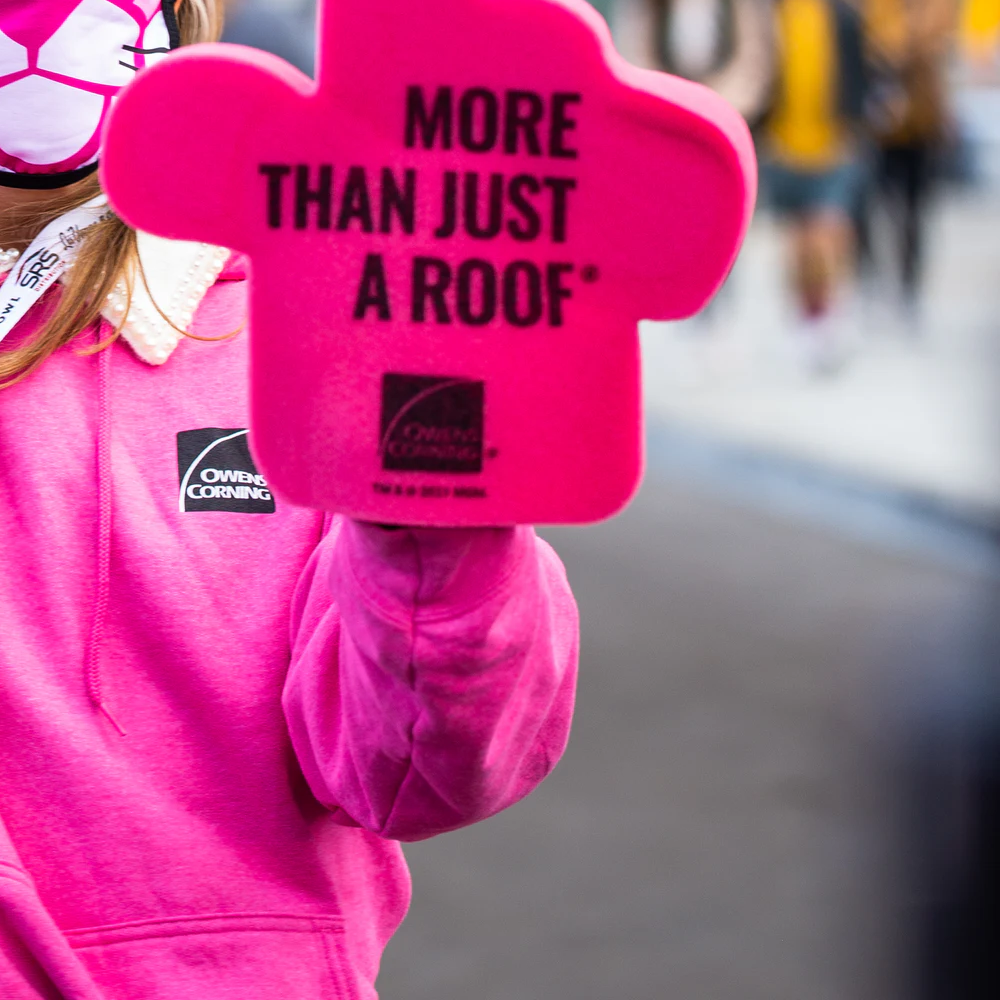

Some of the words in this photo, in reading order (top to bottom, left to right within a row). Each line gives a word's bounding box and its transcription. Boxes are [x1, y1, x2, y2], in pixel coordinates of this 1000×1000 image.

[404, 84, 582, 160] MORE
[258, 163, 416, 236] THAN
[433, 170, 577, 243] JUST
[20, 250, 59, 290] SRS
[352, 253, 392, 321] A
[186, 484, 271, 501] CORNING
[200, 468, 268, 487] OWENS
